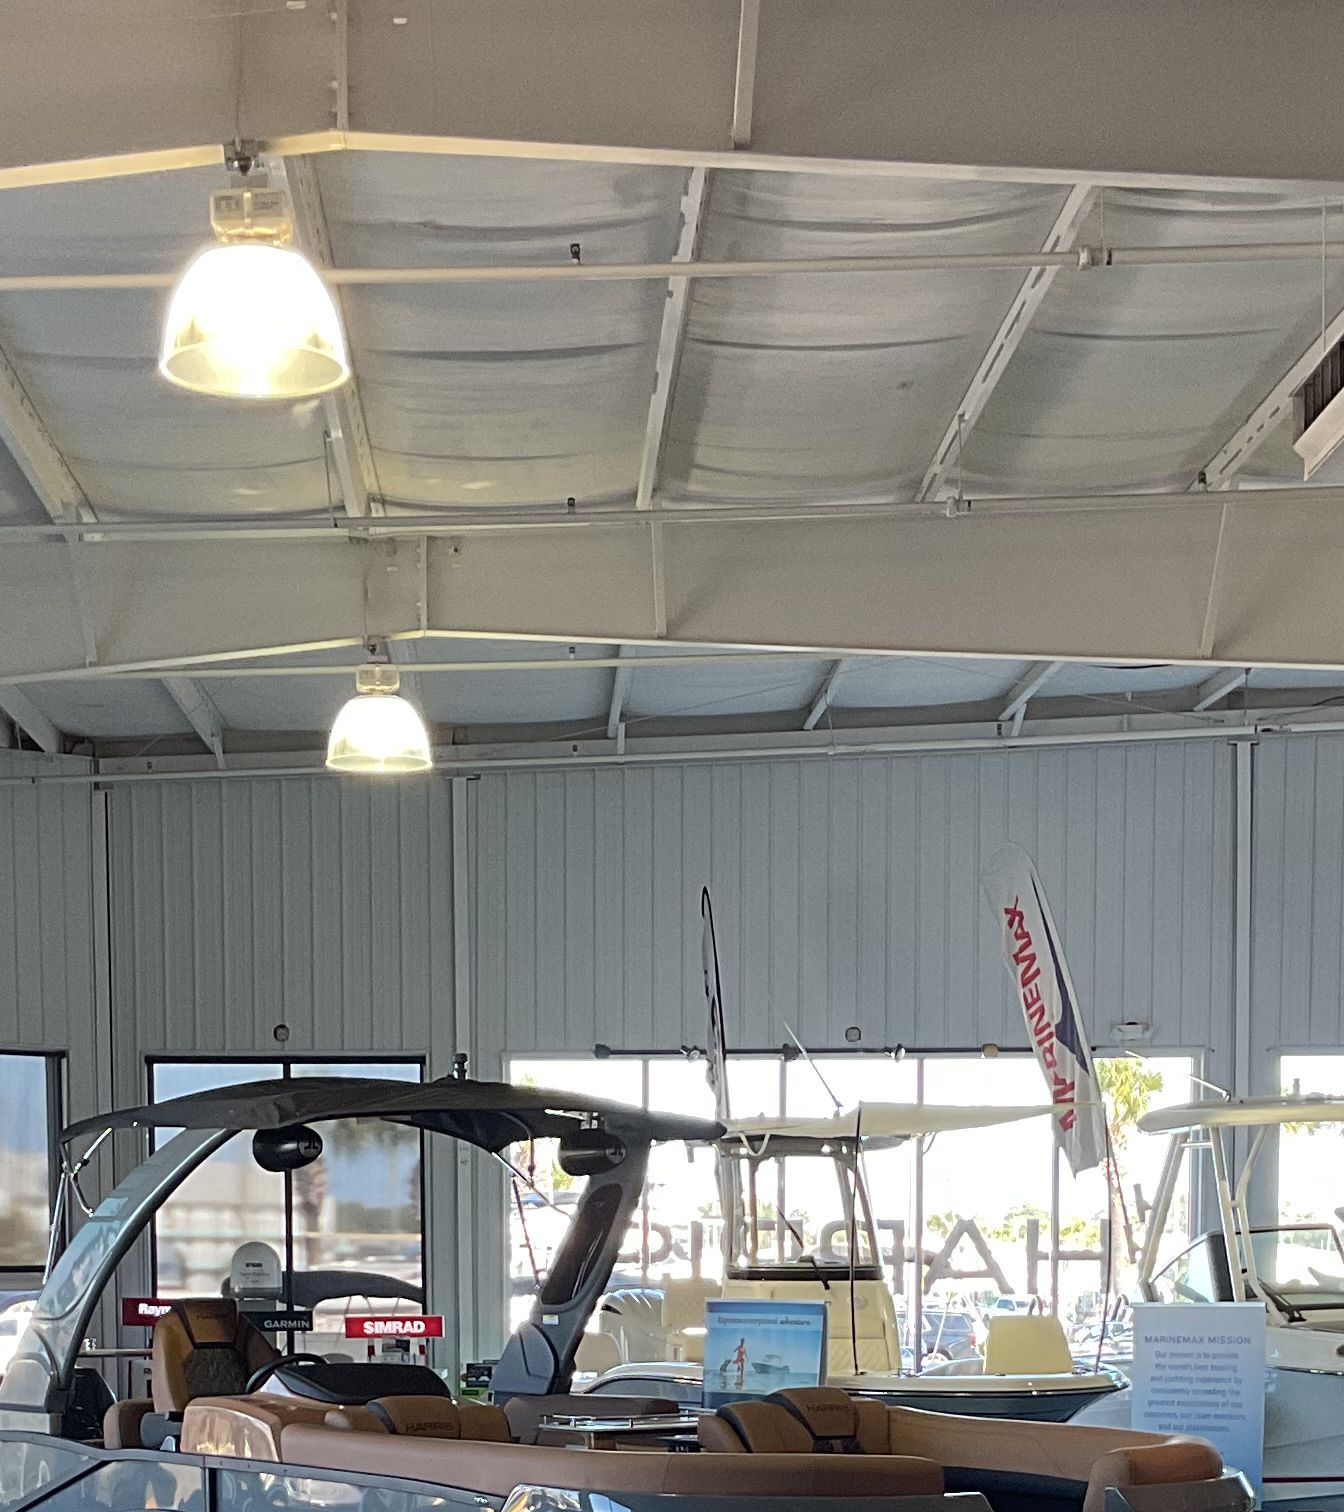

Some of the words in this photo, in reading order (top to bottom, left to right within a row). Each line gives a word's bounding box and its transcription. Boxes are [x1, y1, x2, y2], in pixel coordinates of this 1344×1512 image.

[263, 1319, 310, 1329] GARMIN
[363, 1320, 426, 1335] SIMRAD
[1144, 1335, 1205, 1345] MARINEMAX
[1208, 1335, 1252, 1345] MISSION
[405, 1421, 455, 1433] HARRIS
